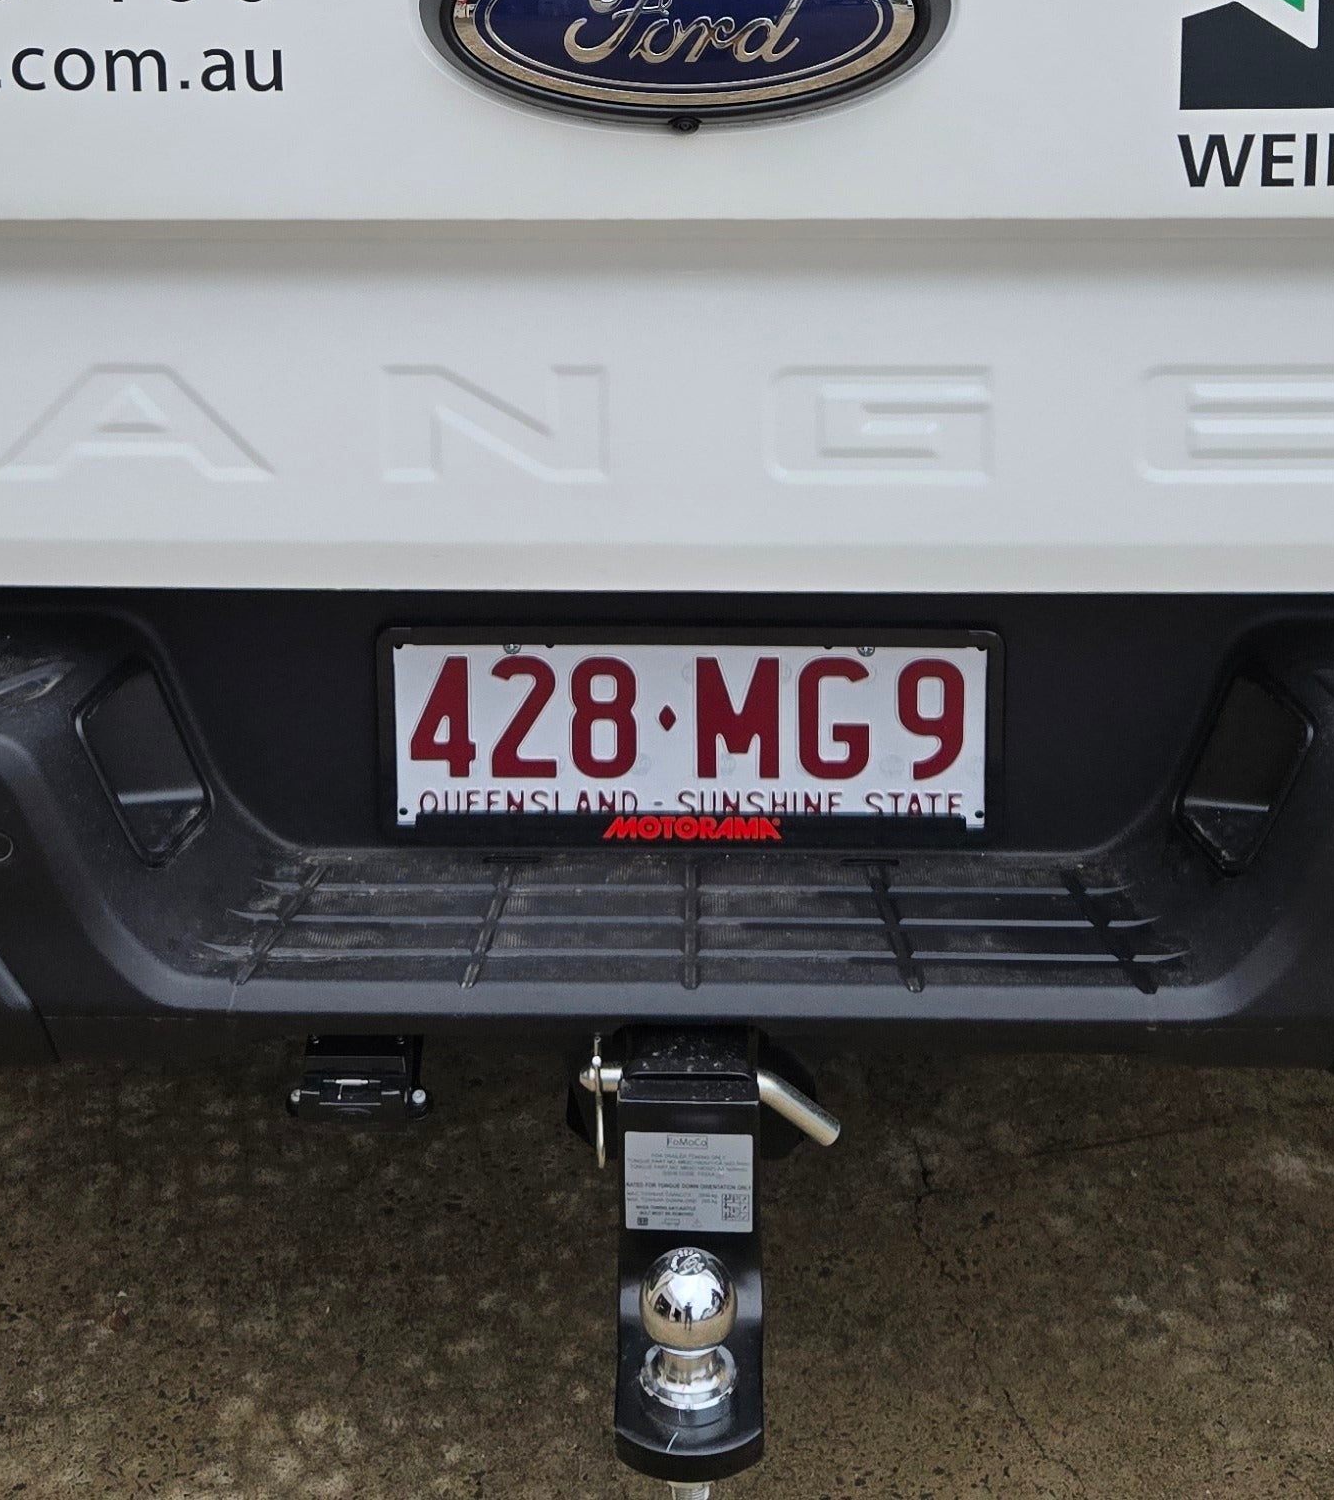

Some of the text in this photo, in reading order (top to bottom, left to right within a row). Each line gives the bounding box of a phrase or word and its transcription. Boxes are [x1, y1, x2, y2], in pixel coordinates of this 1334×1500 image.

[419, 789, 639, 814] QUEENSLAND
[677, 790, 843, 815] SUNSHINE
[865, 791, 963, 817] STATE
[602, 816, 782, 840] MOTORAMA
